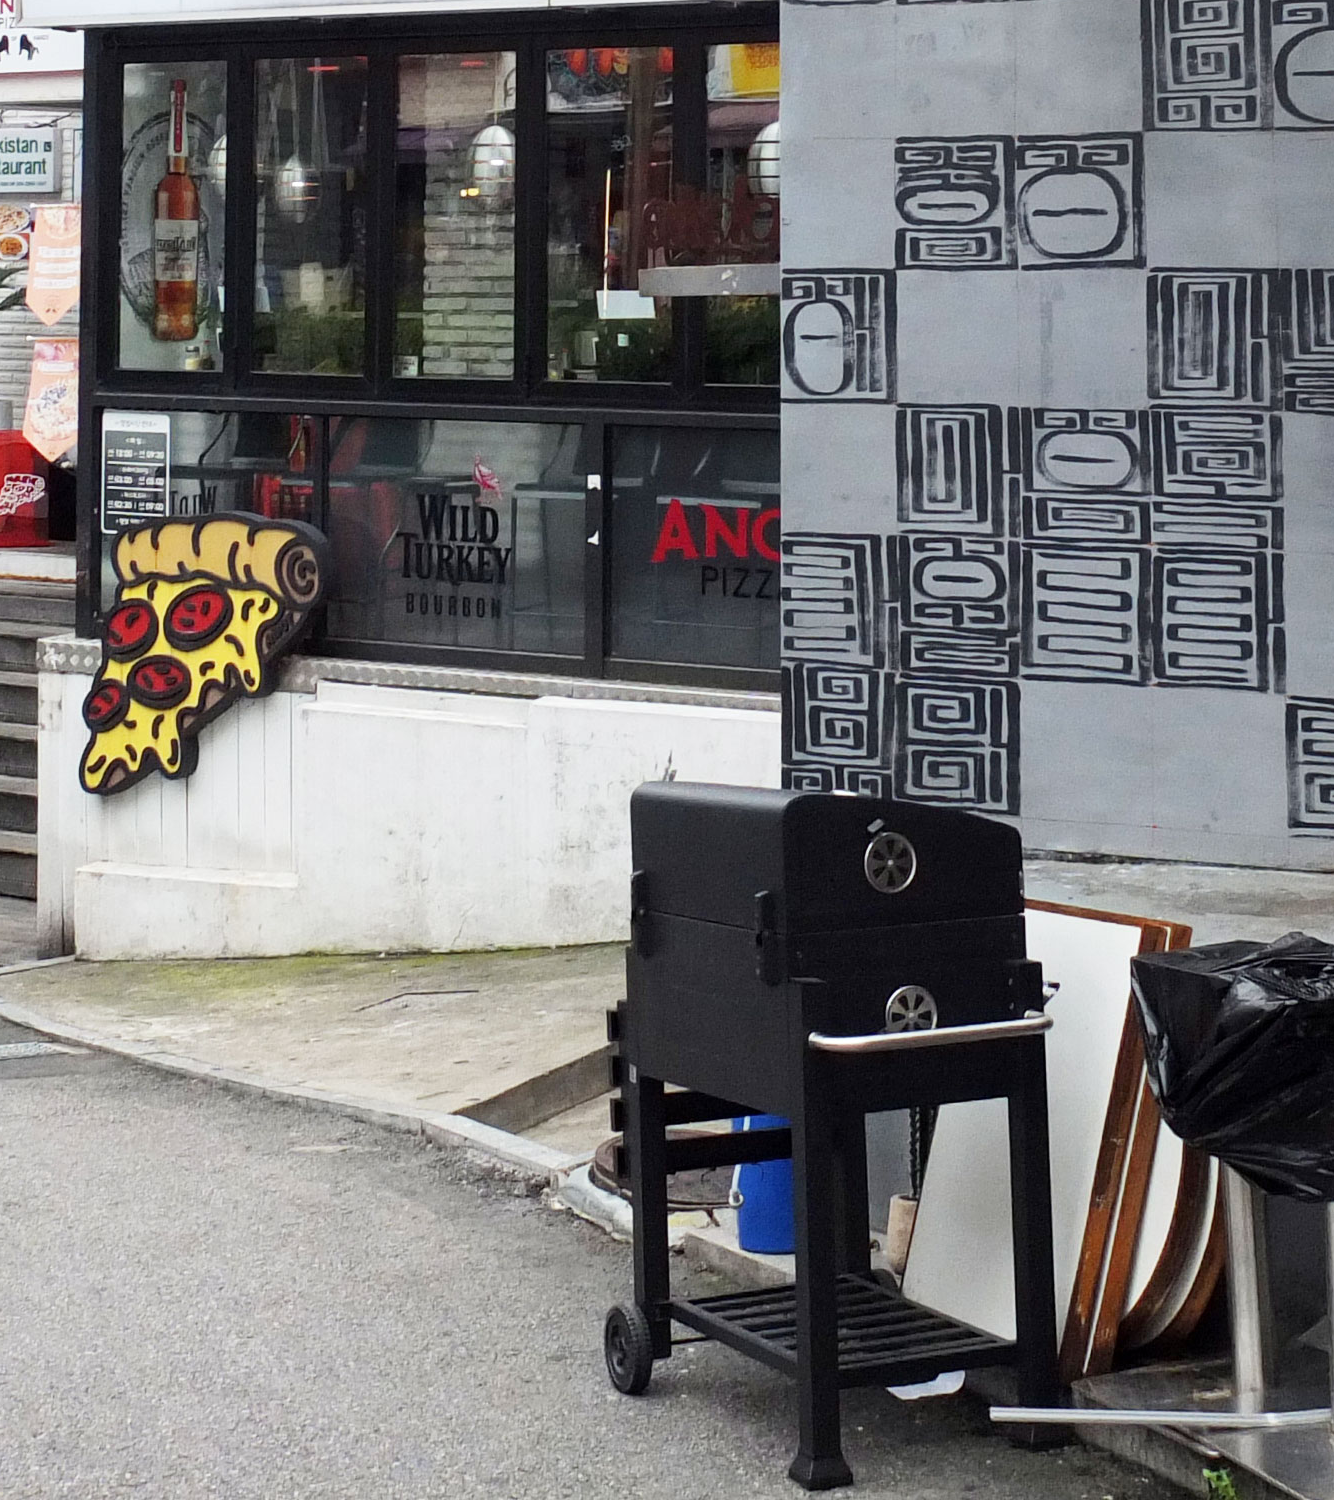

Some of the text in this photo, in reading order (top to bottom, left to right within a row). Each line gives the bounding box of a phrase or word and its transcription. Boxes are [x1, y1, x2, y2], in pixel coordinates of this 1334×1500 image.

[417, 494, 500, 544] WILD
[396, 531, 512, 586] TURKEY
[405, 593, 502, 619] BOURBON
